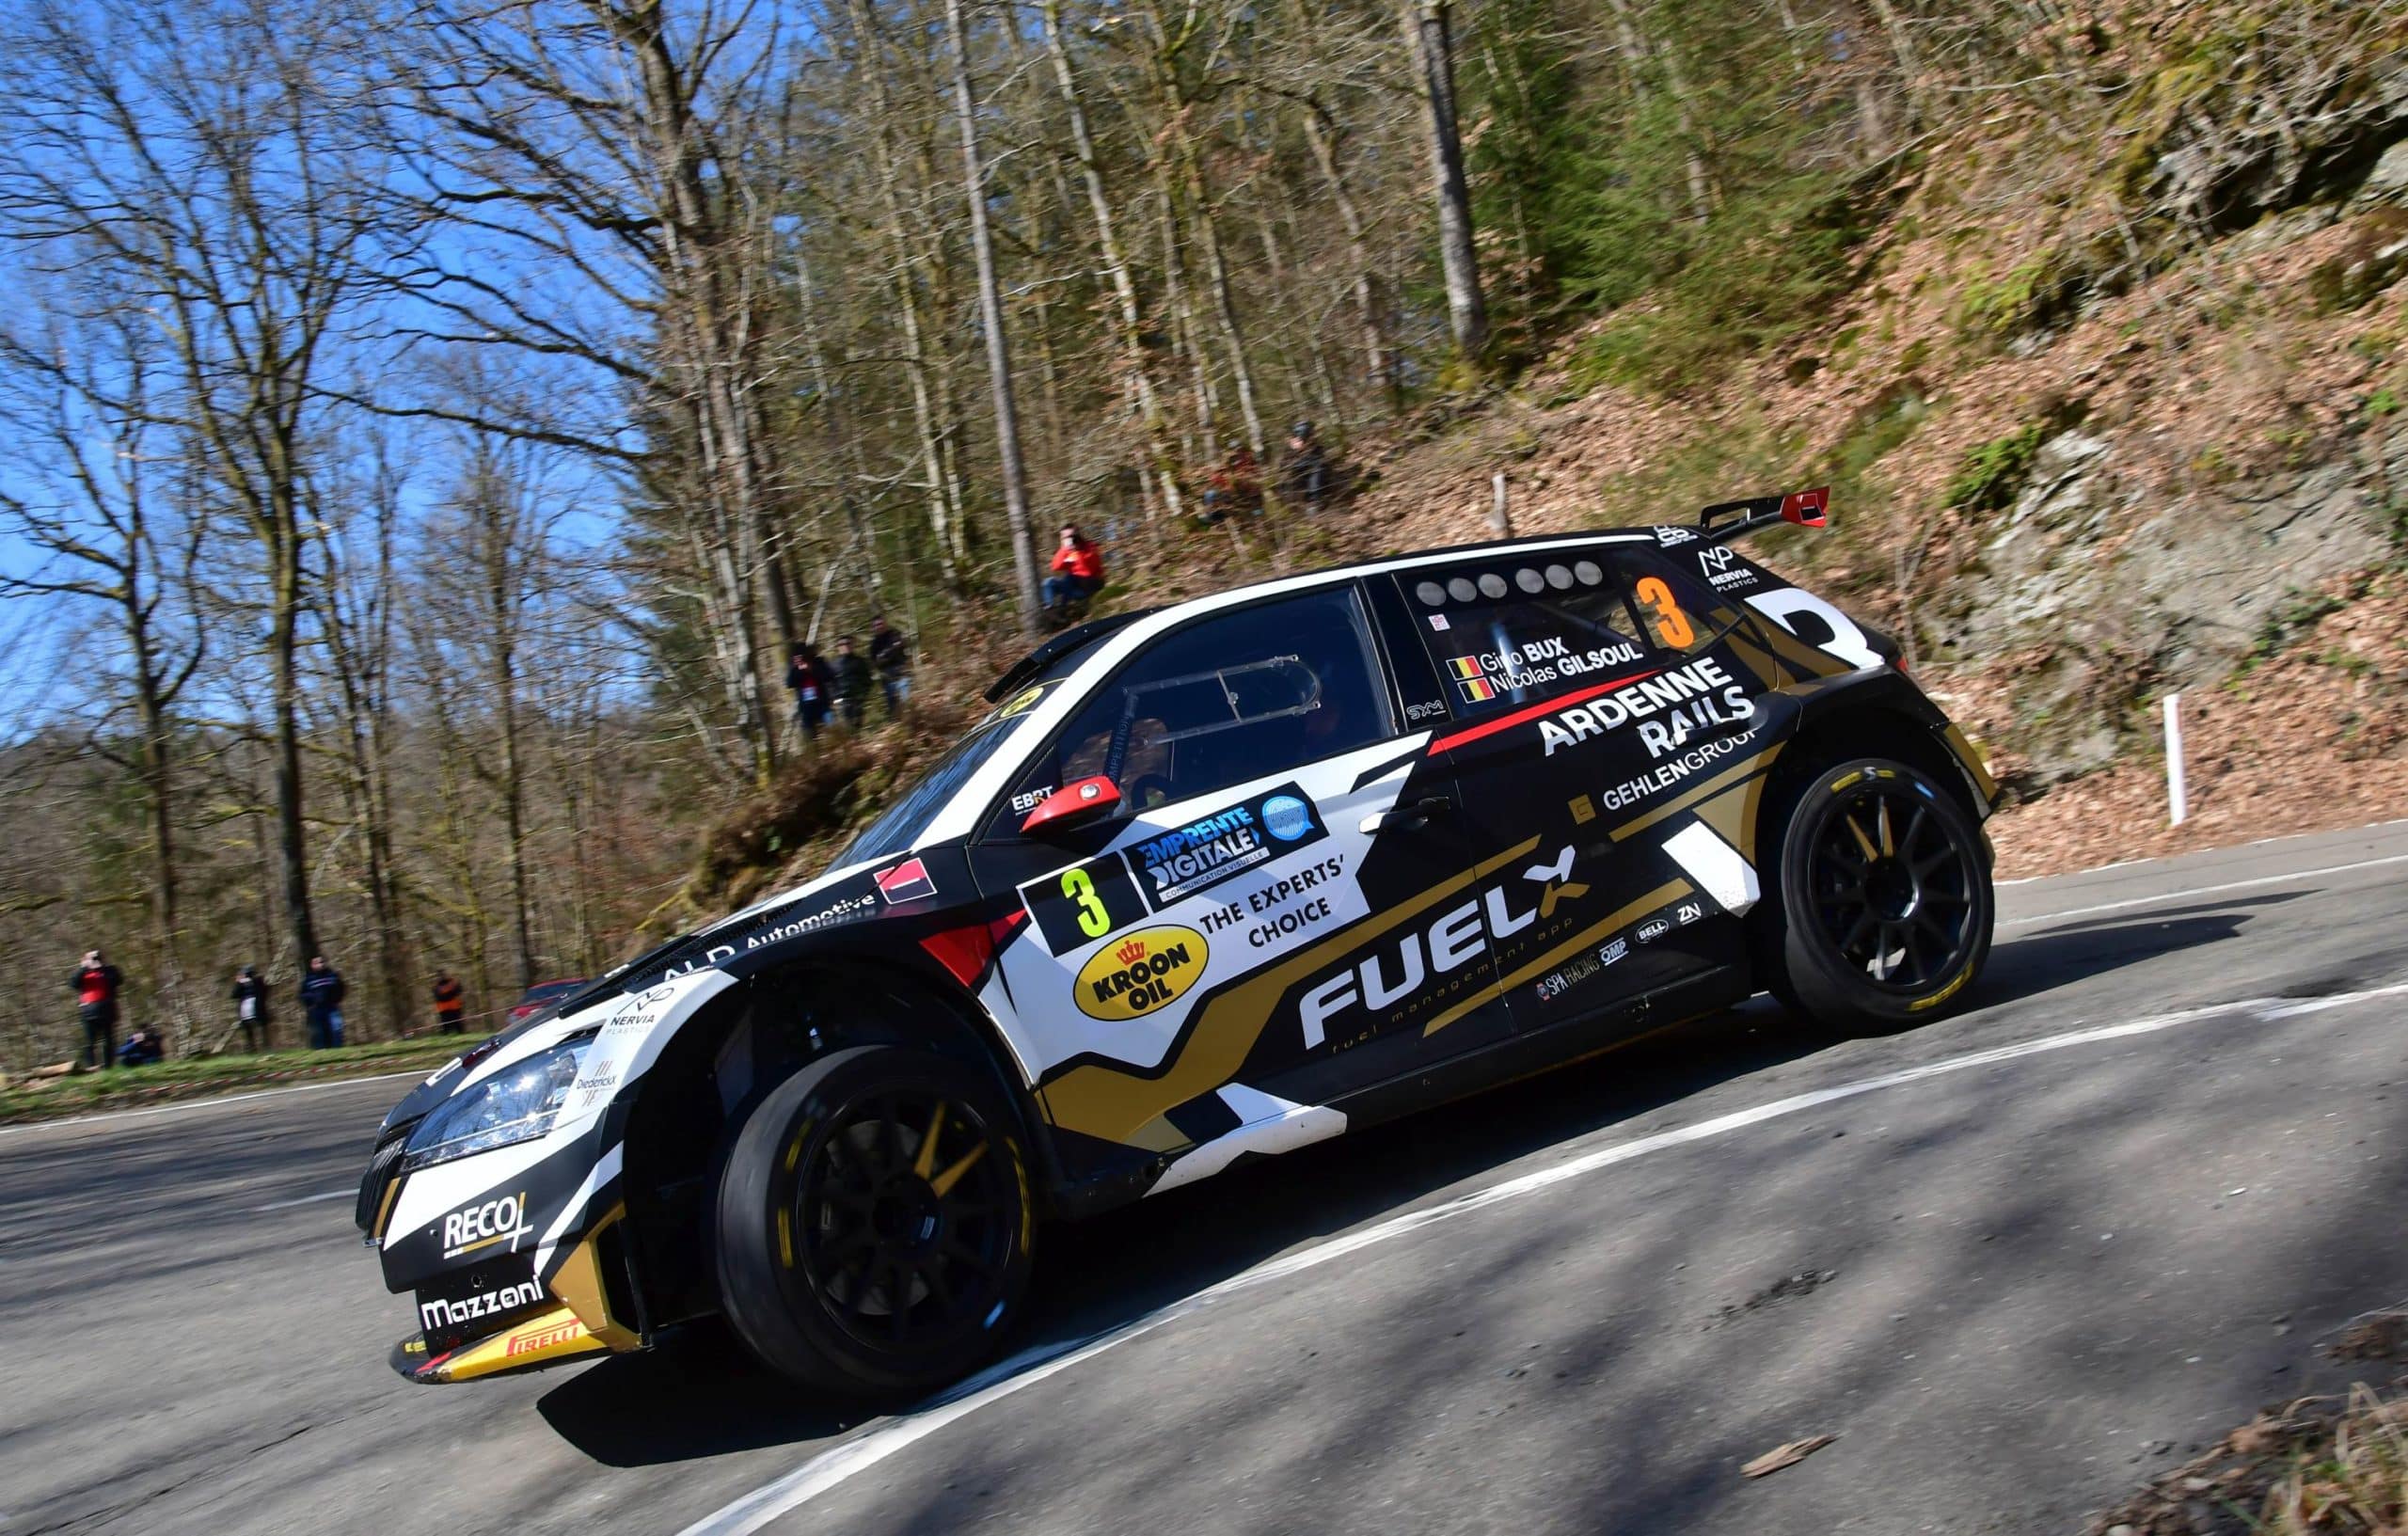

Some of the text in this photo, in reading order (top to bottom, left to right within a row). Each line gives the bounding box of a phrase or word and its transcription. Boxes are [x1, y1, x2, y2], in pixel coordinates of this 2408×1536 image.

[1708, 568, 1753, 586] NERVIA
[1716, 577, 1759, 594] PLASTICS
[1637, 576, 1695, 649] 3
[1489, 642, 1643, 693] Nicolas GILSOUL
[1523, 637, 1570, 660] BUX
[1537, 656, 1734, 757] ARDENNE
[1637, 685, 1756, 758] RAILS
[1147, 828, 1256, 890] DIGITALE
[1164, 851, 1264, 899] COMMUNICATION VISUELLE
[747, 893, 876, 950] Automotive
[1060, 868, 1112, 938] 3
[1199, 902, 1245, 935] THE
[1248, 897, 1332, 948] CHOICE
[1600, 940, 1627, 963] OMP
[1639, 922, 1666, 941] BELL
[1092, 942, 1192, 1004] KROON
[1129, 978, 1175, 1011] OIL
[1391, 942, 1528, 1023] management
[1545, 954, 1600, 997] SPA RACING
[610, 1014, 656, 1026] NERVIA
[420, 1274, 545, 1331] Mazzoni
[505, 1317, 582, 1357] PIRELLI
